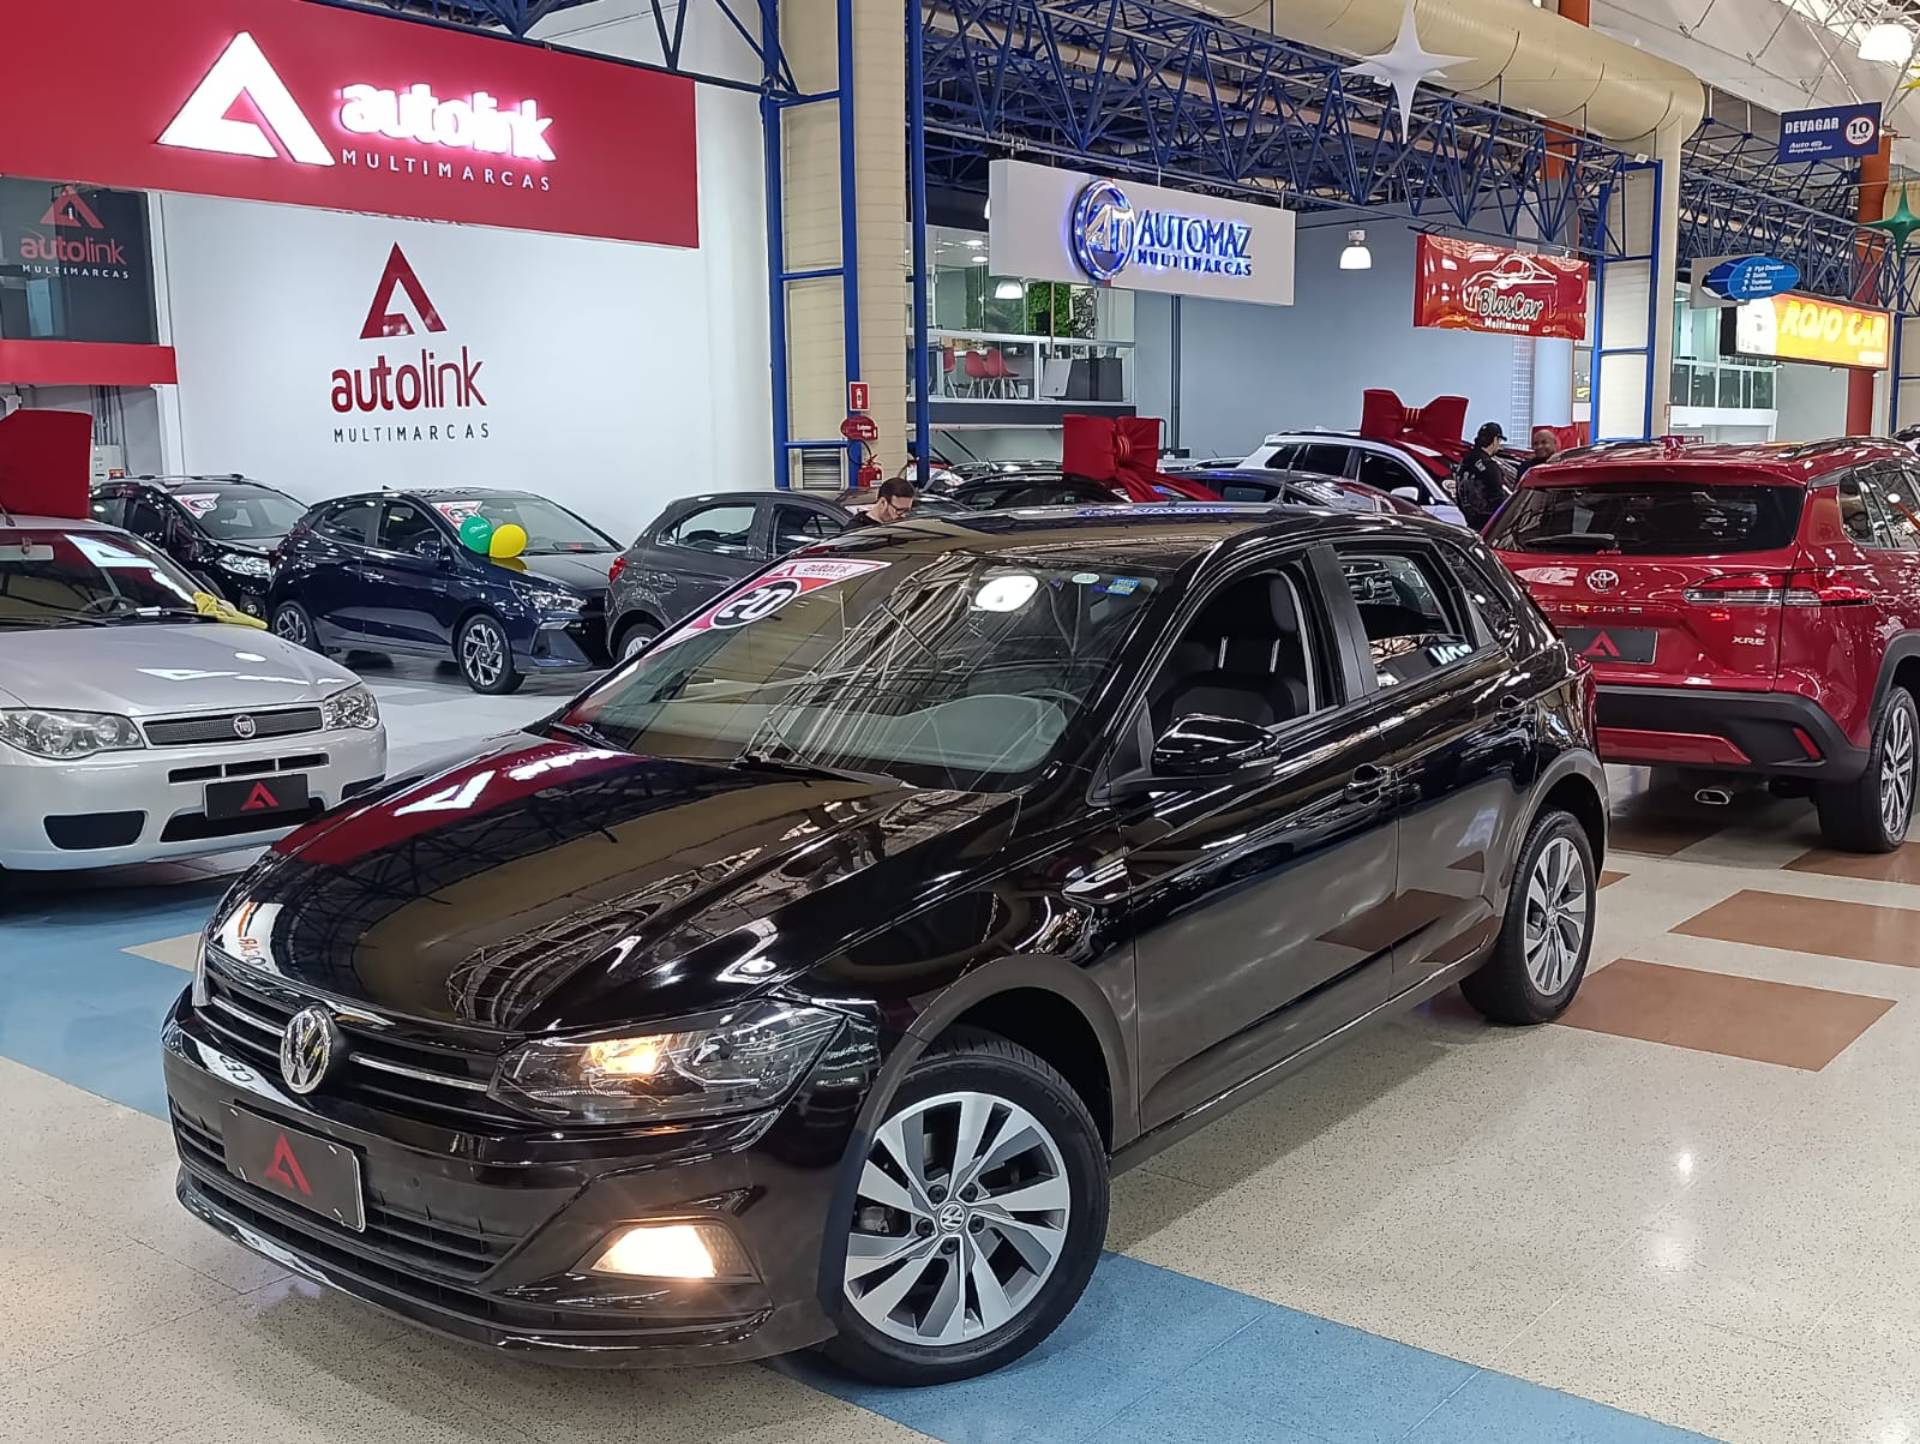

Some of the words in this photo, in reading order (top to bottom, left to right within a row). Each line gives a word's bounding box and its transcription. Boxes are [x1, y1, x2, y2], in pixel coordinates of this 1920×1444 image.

[340, 83, 557, 161] autolink
[1785, 117, 1839, 134] DEVAGAR
[1851, 121, 1870, 135] 10
[342, 149, 550, 191] MULTIMARCAS
[1138, 209, 1253, 259] AUTOMAZ
[20, 236, 127, 265] autolink
[1138, 250, 1253, 276] MULTIMARCAS
[22, 264, 129, 279] MULTIMARCAS
[1480, 287, 1543, 321] BlasCar
[1483, 317, 1530, 331] Multimarcas
[1847, 312, 1886, 348] CAR
[331, 345, 487, 412] autolink
[334, 423, 489, 443] MULTIMARCAS
[718, 588, 792, 620] 20
[1732, 636, 1766, 646] XRE
